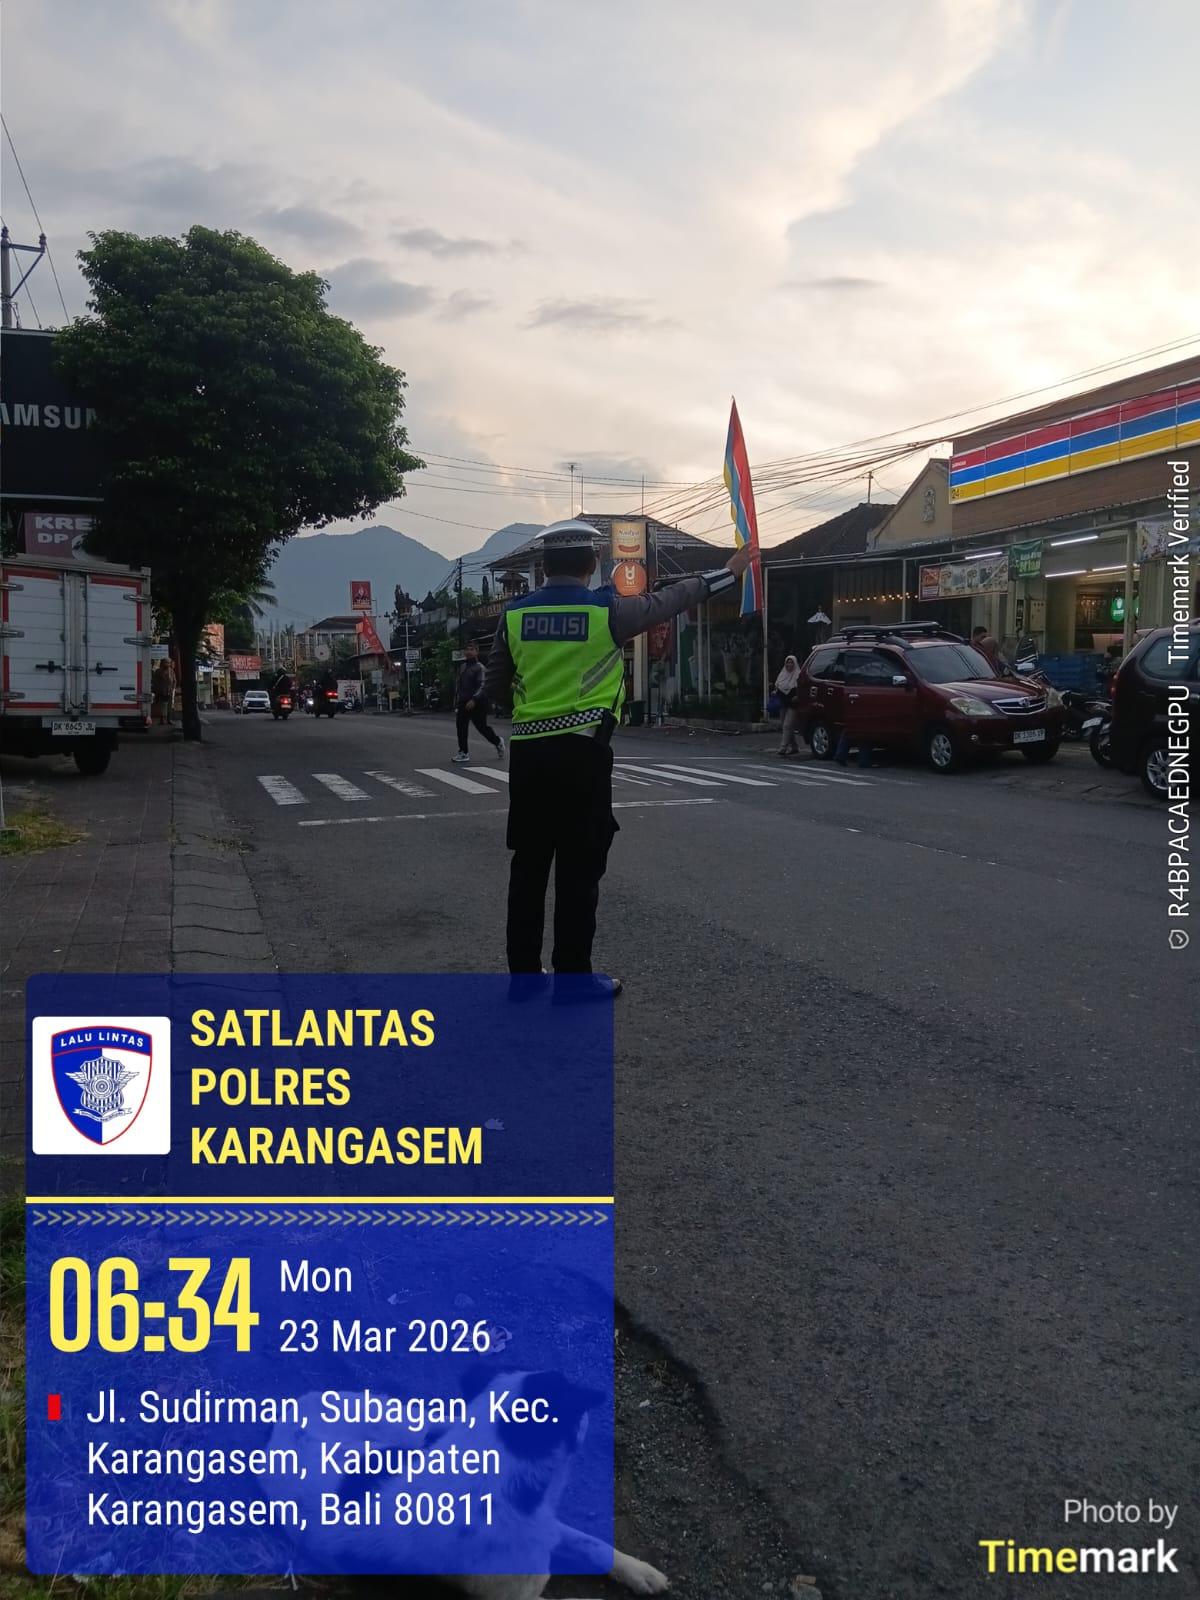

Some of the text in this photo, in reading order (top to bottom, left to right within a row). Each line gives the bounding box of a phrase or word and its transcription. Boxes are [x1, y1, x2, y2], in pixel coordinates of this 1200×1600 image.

[34, 516, 98, 531] KRE
[37, 532, 69, 544] DP
[524, 616, 586, 636] POLISI
